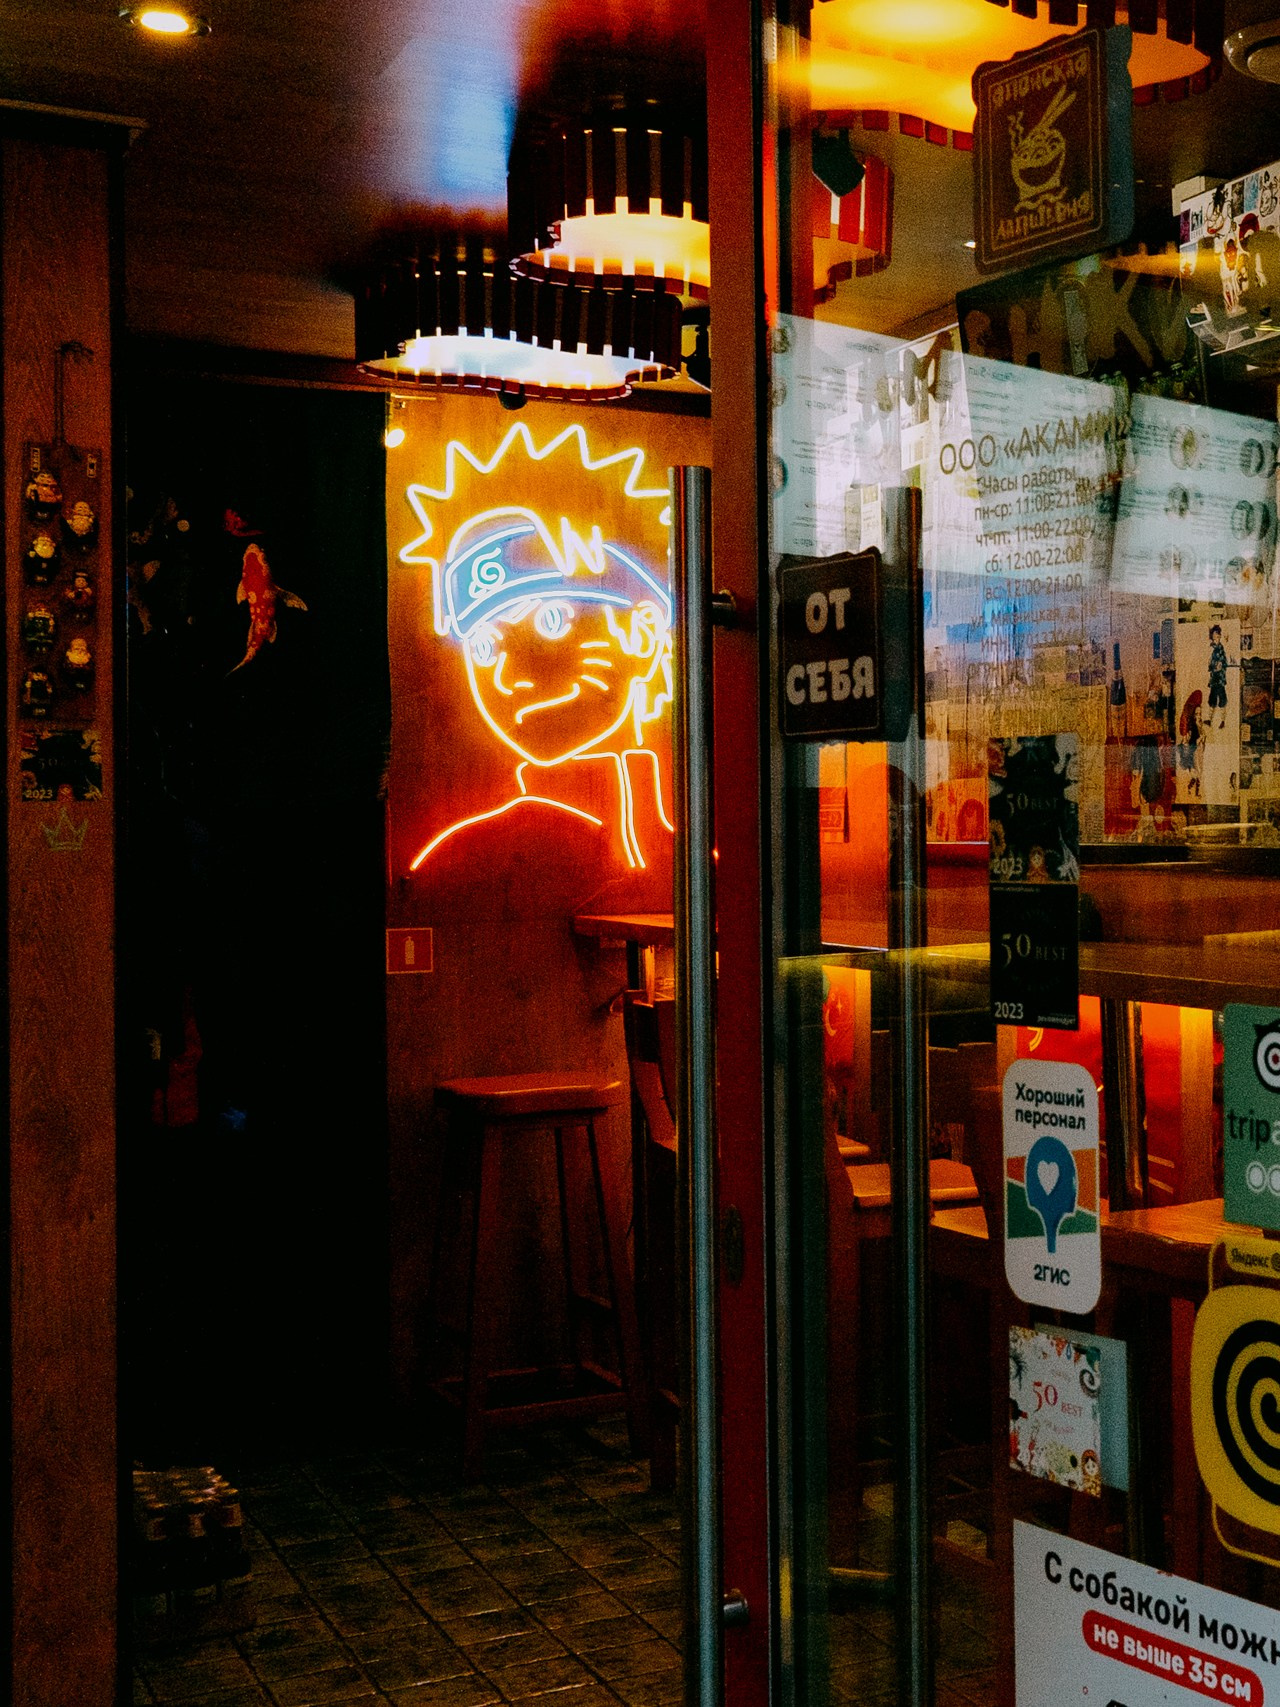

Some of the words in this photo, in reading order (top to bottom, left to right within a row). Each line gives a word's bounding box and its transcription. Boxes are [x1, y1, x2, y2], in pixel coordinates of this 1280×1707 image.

[939, 434, 996, 475] ООО
[1022, 465, 1077, 493] работы
[974, 502, 1012, 521] пн-ср:
[985, 553, 1003, 573] сб:
[1006, 545, 1083, 571] 12:00-22:00
[805, 587, 851, 634] ОТ
[786, 655, 875, 705] СЕБЯ
[992, 857, 1023, 875] 2023
[1000, 932, 1032, 969] 50
[1034, 945, 1068, 961] BEST
[994, 1001, 1025, 1020] 2023
[1015, 1081, 1086, 1109] Хороший
[1015, 1108, 1086, 1131] персонал
[1231, 1247, 1269, 1268] Яндекс
[1033, 1263, 1071, 1286] 2ГИС
[1032, 1381, 1058, 1413] 50
[1061, 1402, 1083, 1418] BEST
[1045, 1551, 1062, 1584] С
[1069, 1568, 1190, 1633] собакой
[1094, 1624, 1119, 1650] не
[1123, 1635, 1185, 1675] выше
[1188, 1655, 1218, 1690] 35
[1221, 1672, 1251, 1702] см
